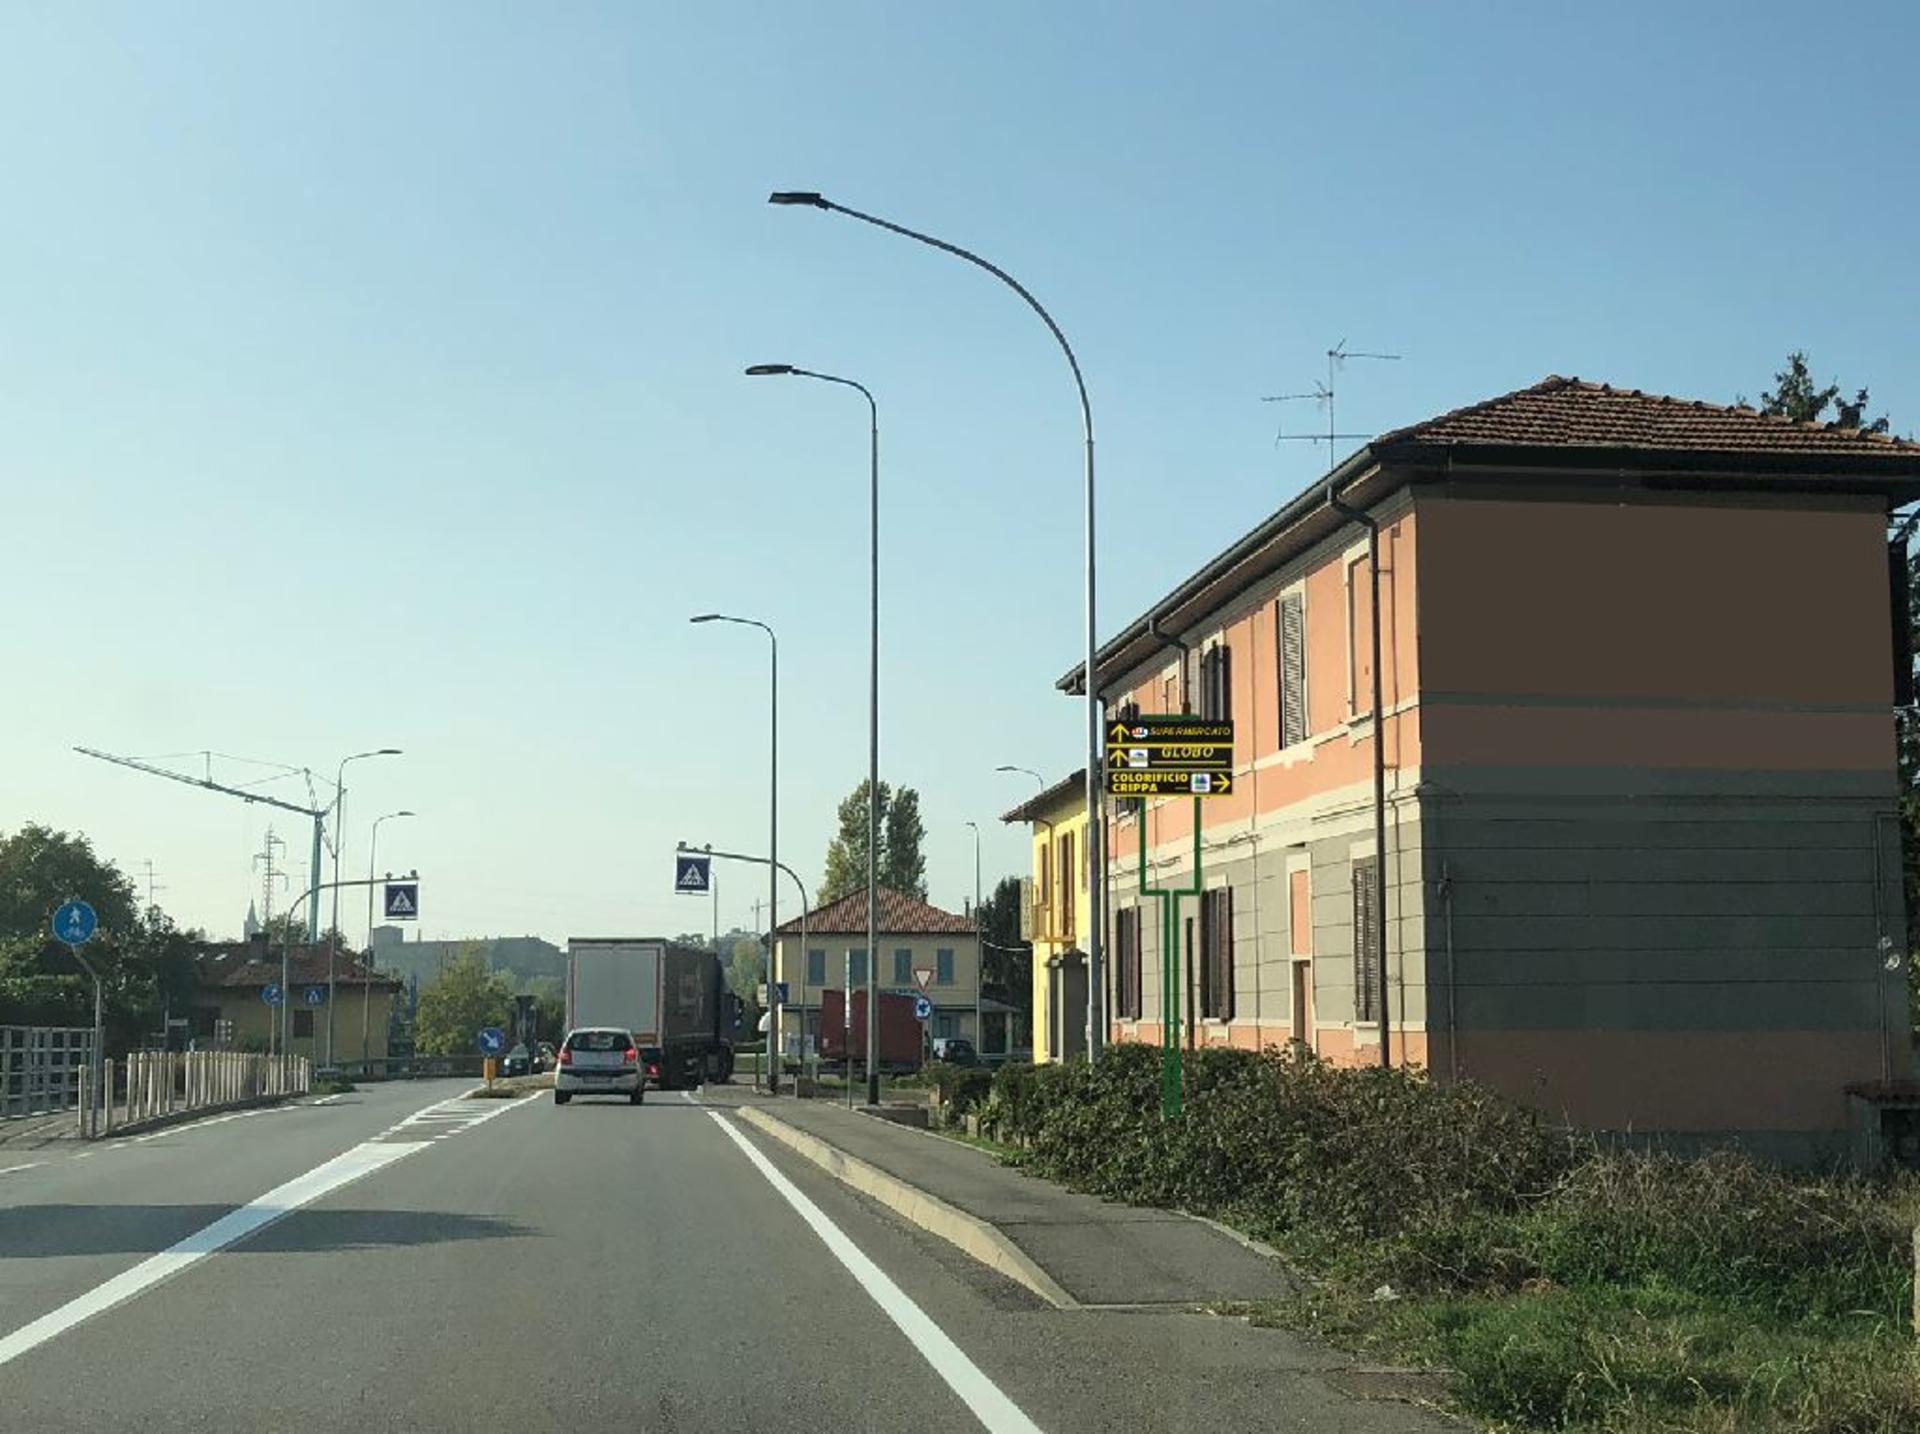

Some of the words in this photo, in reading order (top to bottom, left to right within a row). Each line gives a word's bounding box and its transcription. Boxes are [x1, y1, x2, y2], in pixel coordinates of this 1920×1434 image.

[1161, 747, 1214, 758] GLOBO
[1112, 773, 1189, 782] COLORIFICIO
[1112, 783, 1158, 792] CRIPPA
